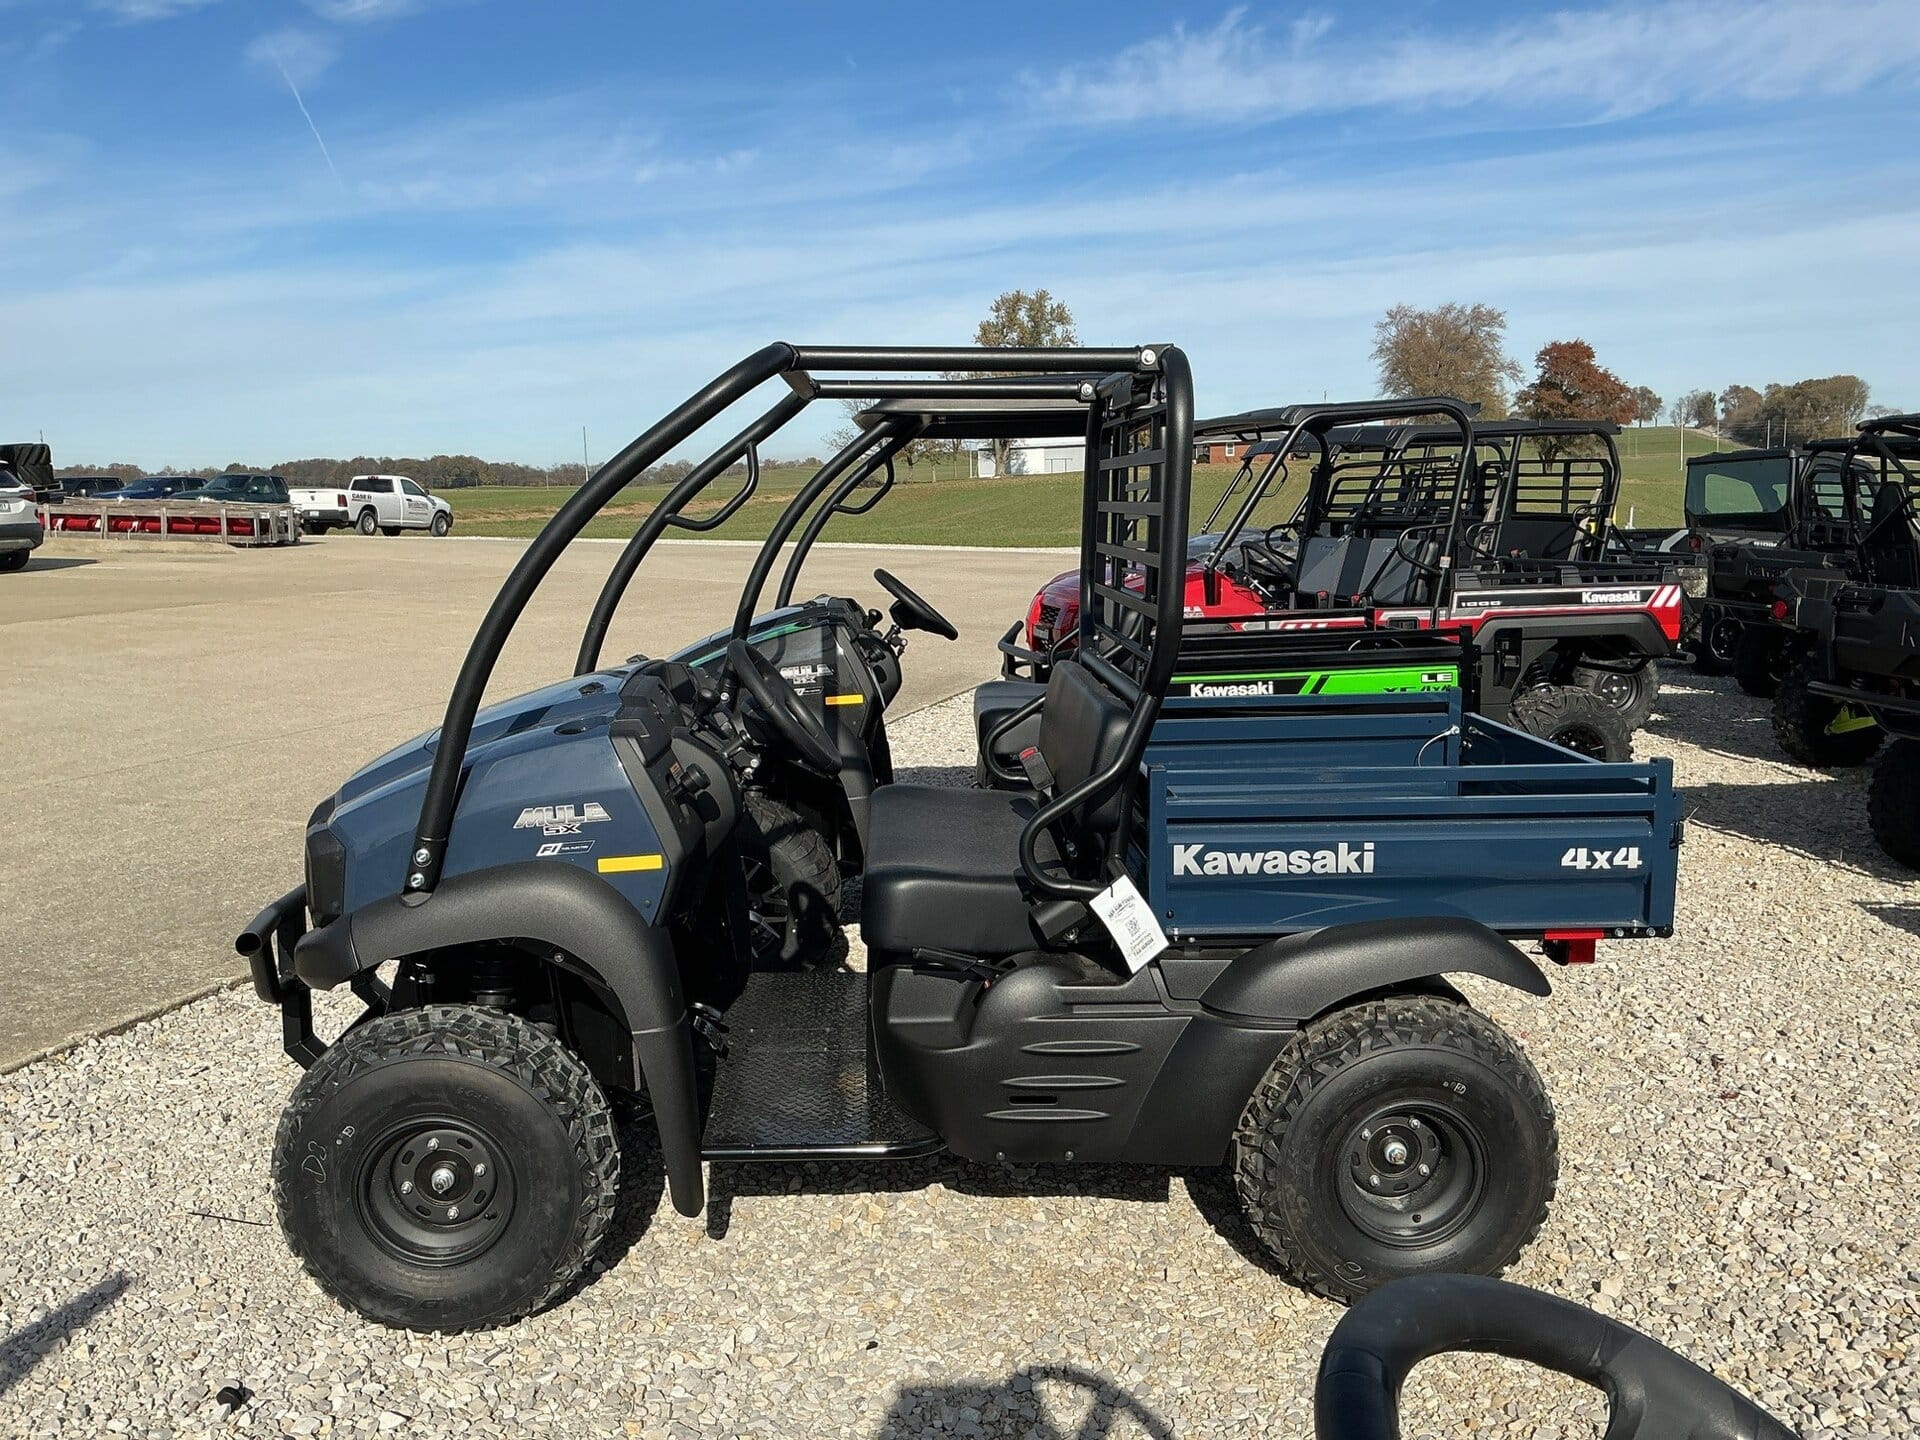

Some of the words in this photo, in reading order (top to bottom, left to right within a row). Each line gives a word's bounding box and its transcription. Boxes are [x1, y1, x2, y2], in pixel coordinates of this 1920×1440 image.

[1582, 590, 1640, 604] Kawasaki
[1421, 672, 1453, 683] LE
[1190, 681, 1274, 698] Kawasaki
[513, 802, 612, 829] MULE
[543, 822, 581, 836] SX
[1173, 842, 1375, 876] Kawasaki
[1561, 847, 1643, 870] 4x4
